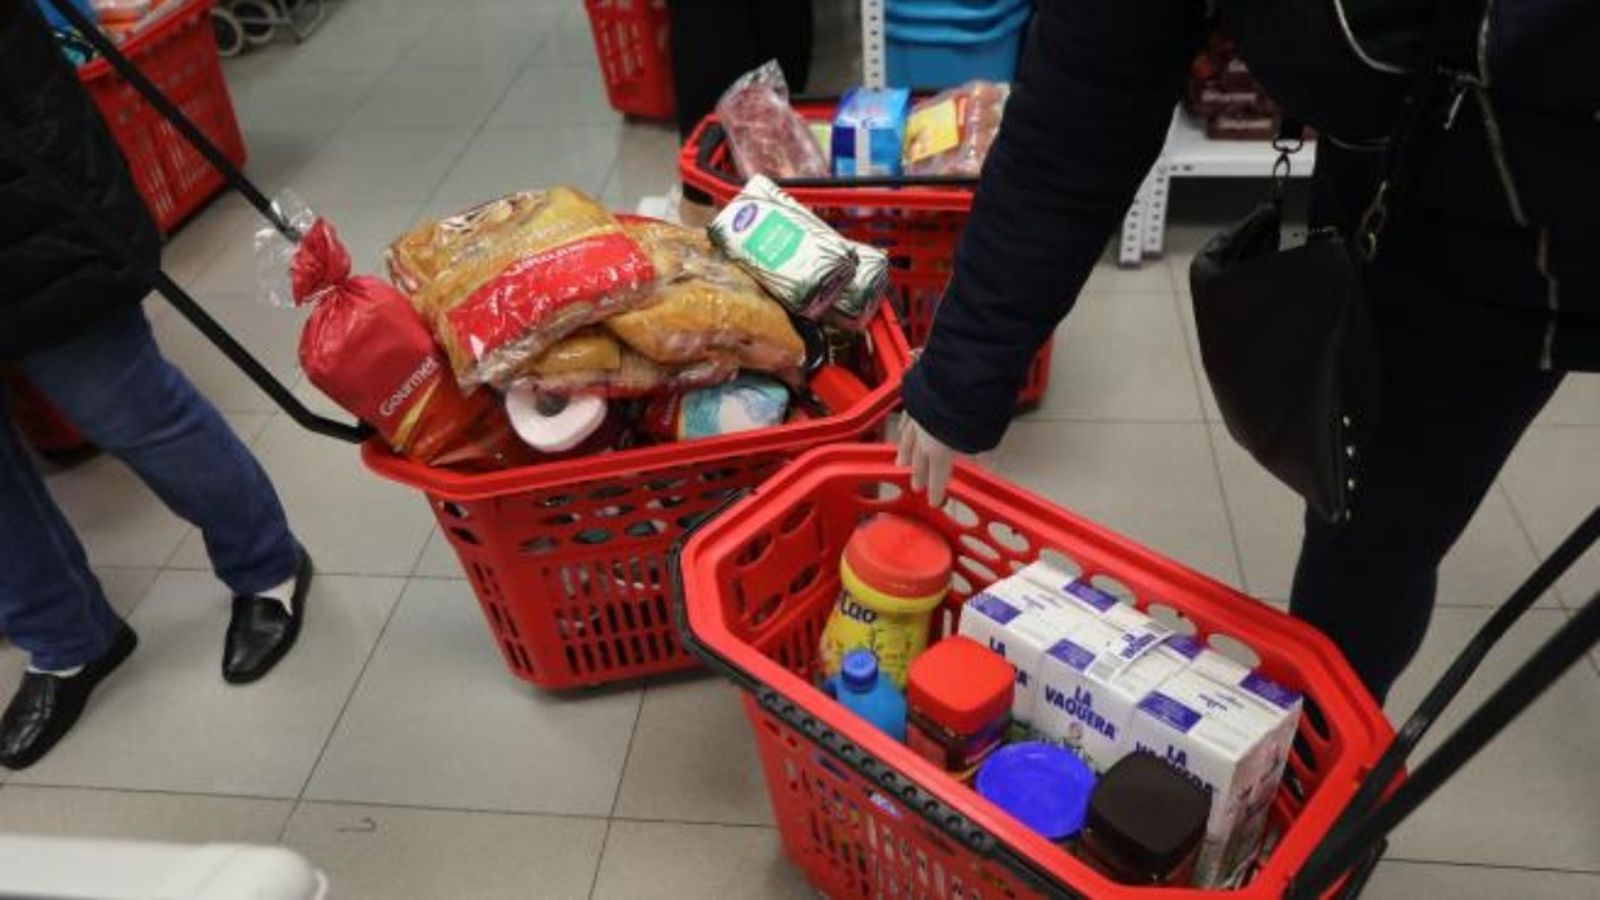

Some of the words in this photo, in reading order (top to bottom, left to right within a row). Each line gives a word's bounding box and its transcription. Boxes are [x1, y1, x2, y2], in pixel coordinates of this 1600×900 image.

[379, 355, 439, 416] Gourmet
[1045, 685, 1116, 740] VAQUERA
[1074, 685, 1092, 707] LA
[1167, 744, 1187, 768] LA
